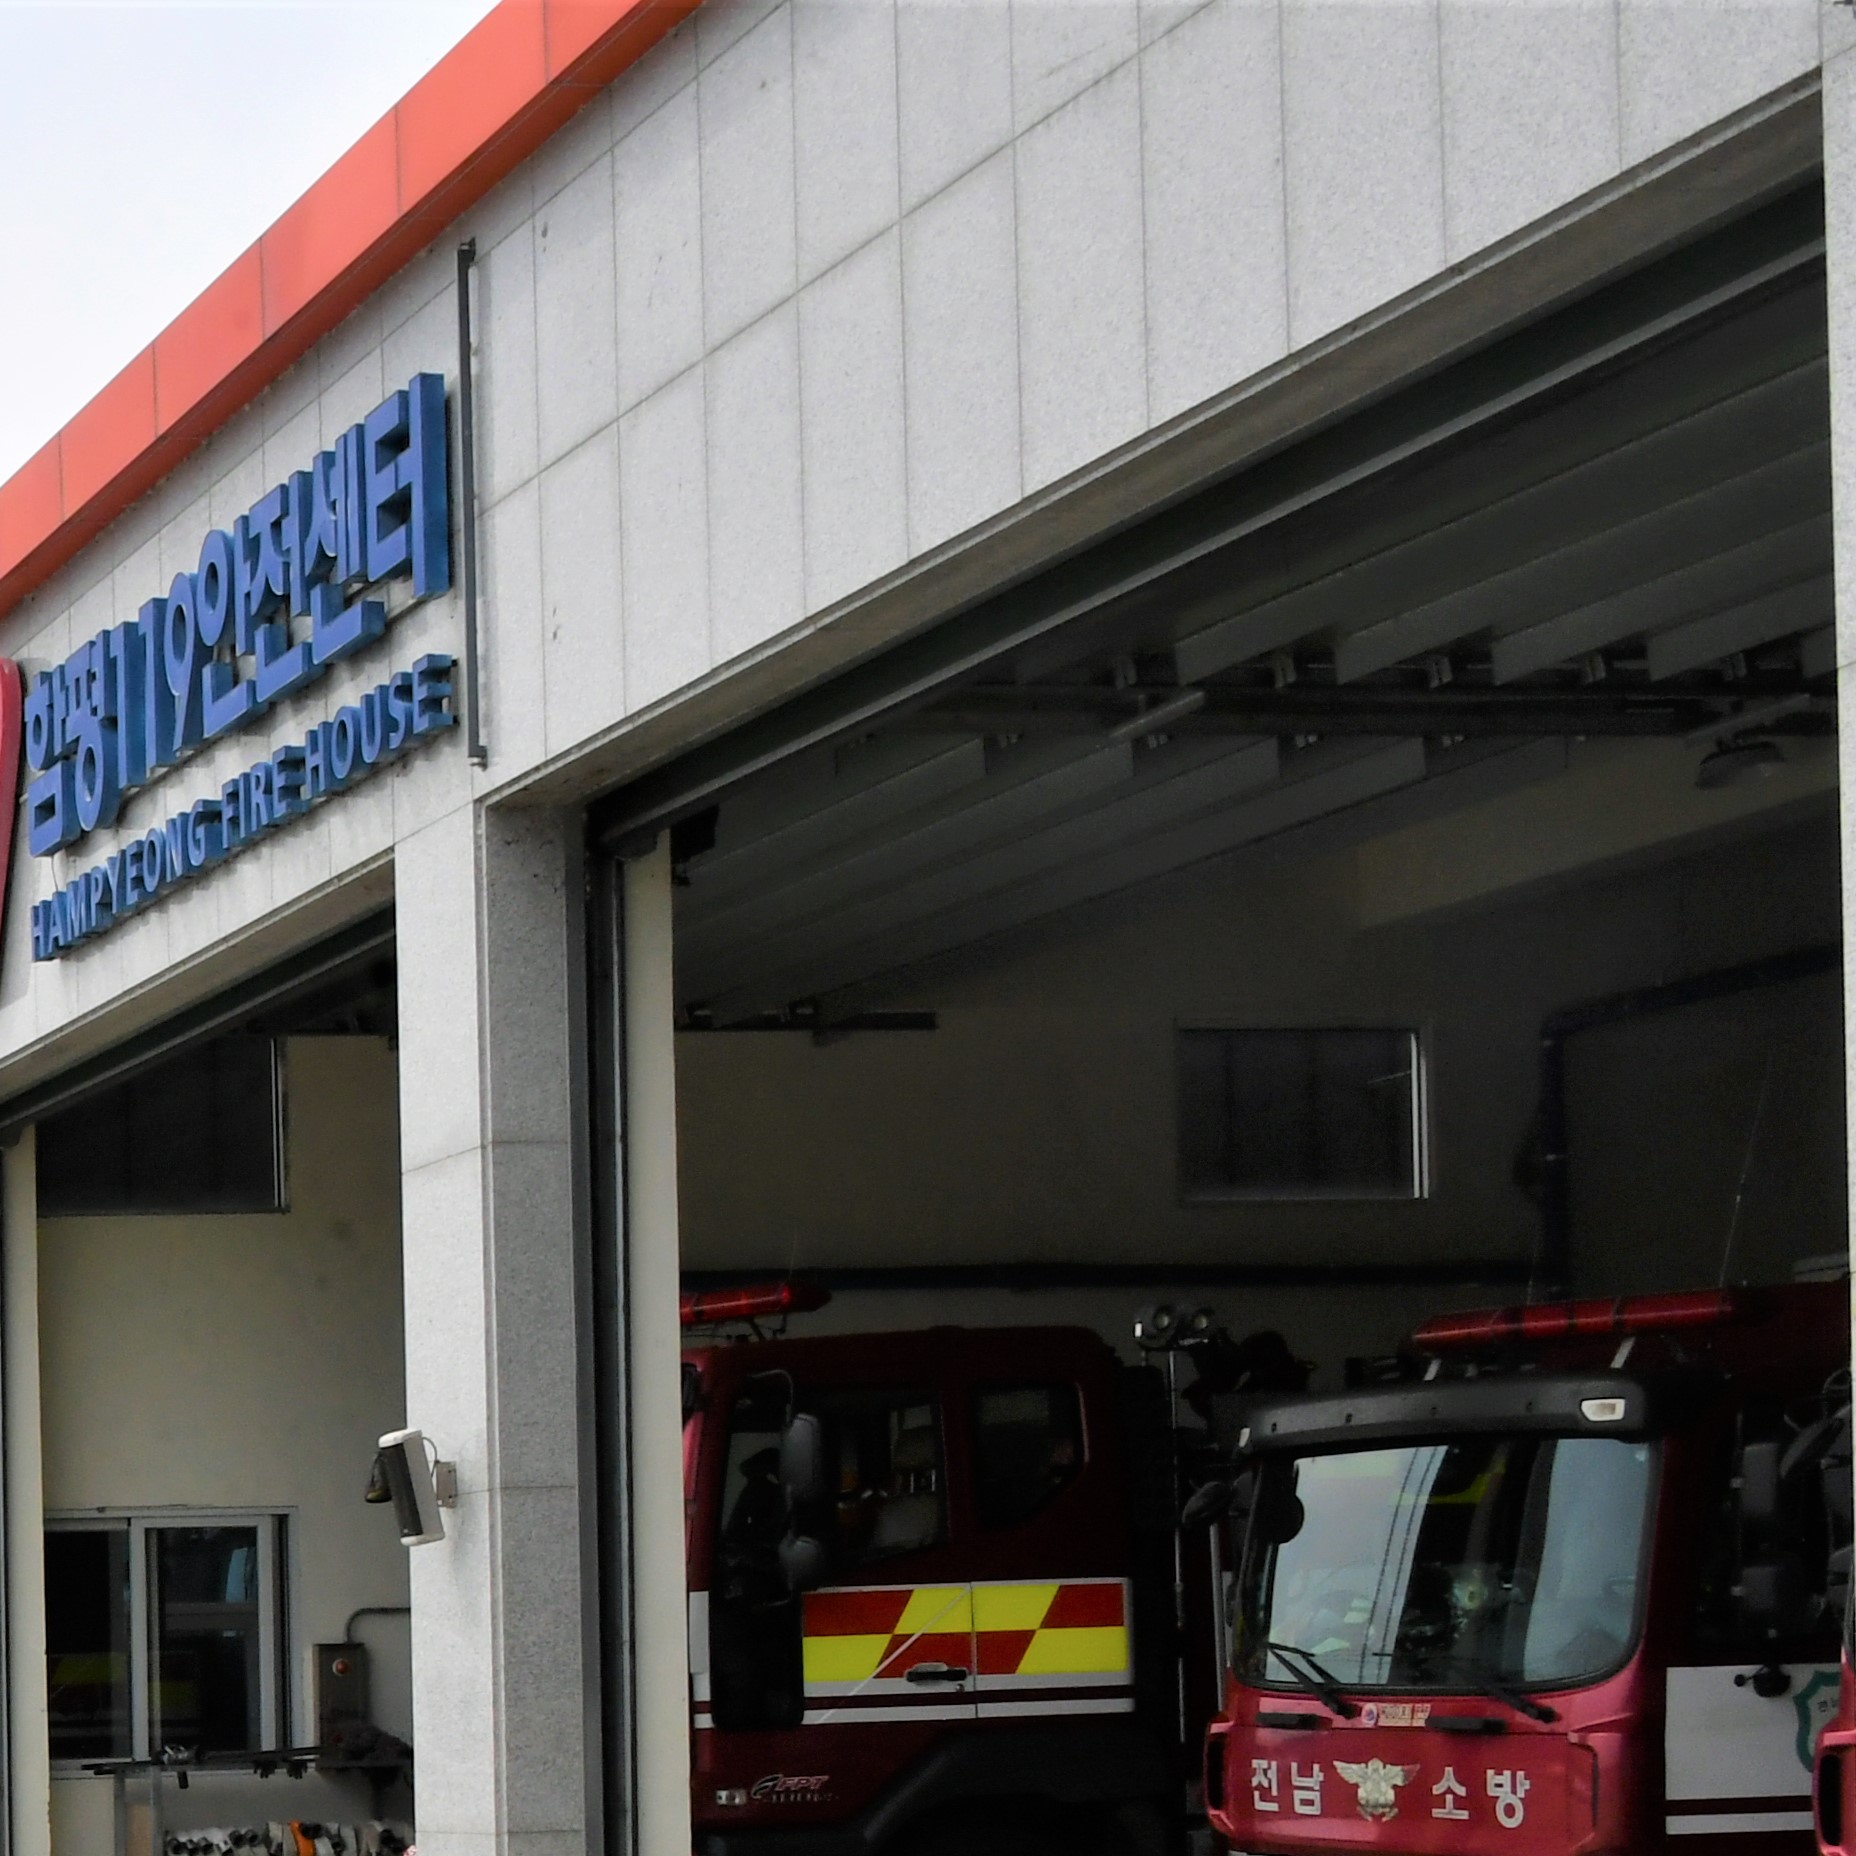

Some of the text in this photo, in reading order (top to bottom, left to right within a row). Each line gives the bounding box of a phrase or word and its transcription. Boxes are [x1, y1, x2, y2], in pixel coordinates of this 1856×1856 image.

[24, 373, 451, 857] 함평119안전센터
[31, 654, 457, 961] HAMPYEONG FIRE HOUSE
[1251, 1758, 1531, 1829] 전남 소방
